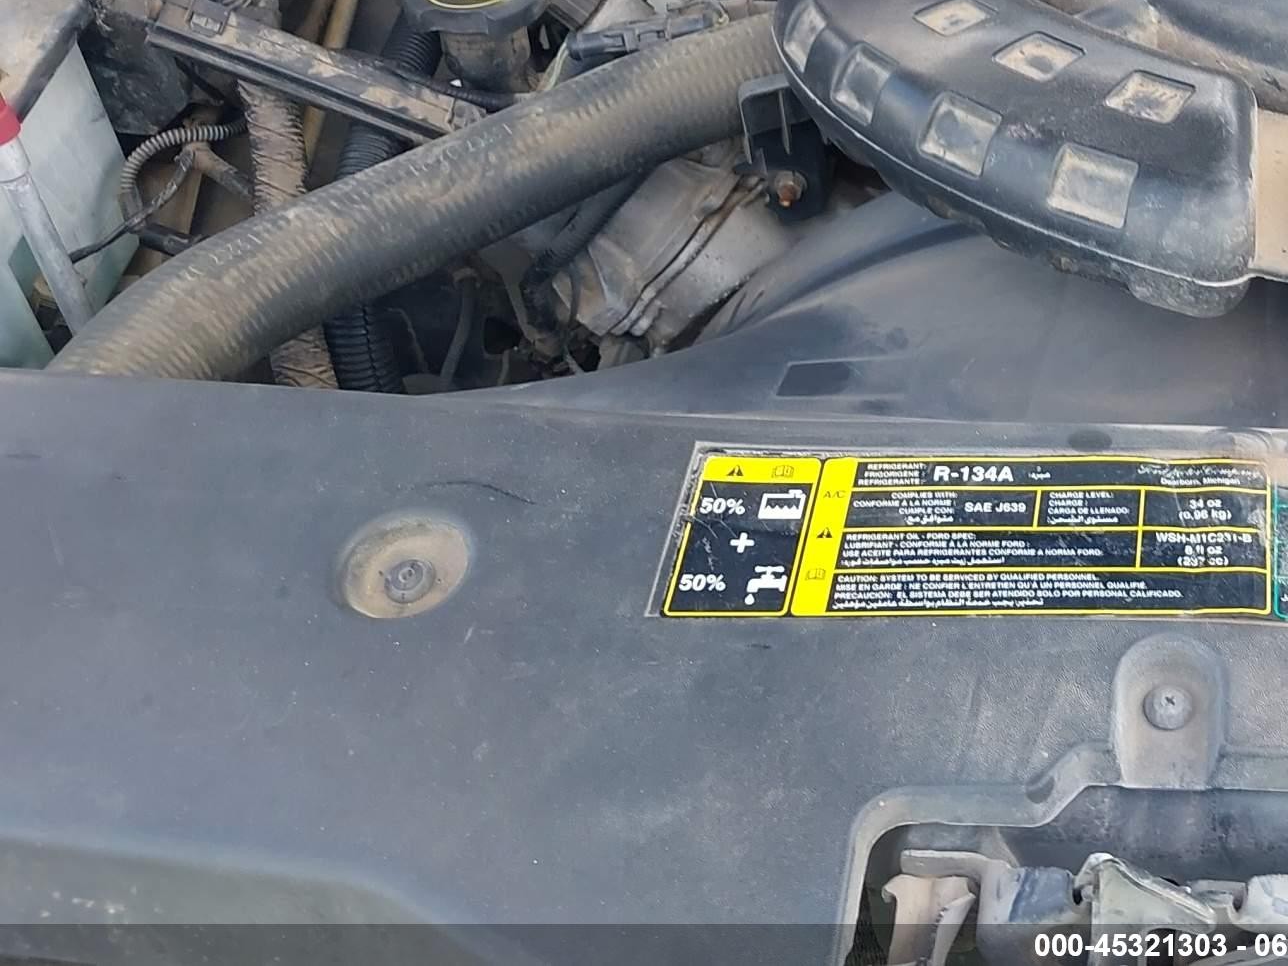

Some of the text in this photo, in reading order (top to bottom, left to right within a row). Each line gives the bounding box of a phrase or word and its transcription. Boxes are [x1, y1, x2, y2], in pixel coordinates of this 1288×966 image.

[933, 465, 1014, 482] R-134A
[891, 491, 933, 499] COMPLIES
[699, 497, 746, 515] 50%
[964, 502, 1027, 513] SAE J639
[1190, 499, 1222, 508] 34 oz
[1047, 507, 1076, 515] CARGA
[1077, 507, 1088, 515] DE
[1211, 509, 1232, 521] kg)
[846, 533, 904, 541] REFRIGERANT
[906, 533, 920, 541] OIL
[900, 540, 947, 549] CONFORME
[970, 540, 1000, 548] NORME
[1001, 540, 1025, 548] FORD
[842, 549, 859, 557] USE
[861, 549, 891, 557] ACEITE
[892, 549, 916, 557] PARA
[988, 548, 1036, 556] CONFORME
[1045, 548, 1076, 556] NORMA
[1206, 545, 1223, 555] oz
[679, 573, 727, 592] 50%
[880, 574, 915, 582] SYSTEM
[916, 574, 928, 582] TO
[929, 574, 941, 582] BE
[942, 574, 985, 582] SERVICED
[987, 574, 999, 582] BY
[1000, 573, 1045, 582] QUALIFIED
[858, 583, 870, 591] EN
[1040, 582, 1052, 590] UN
[1054, 581, 1105, 590] PERSONNEL
[896, 591, 906, 599] EL
[972, 591, 990, 599] SER
[991, 590, 1035, 598] ATENDIDO
[1062, 590, 1081, 598] POR
[1082, 589, 1128, 598] PERSONAL
